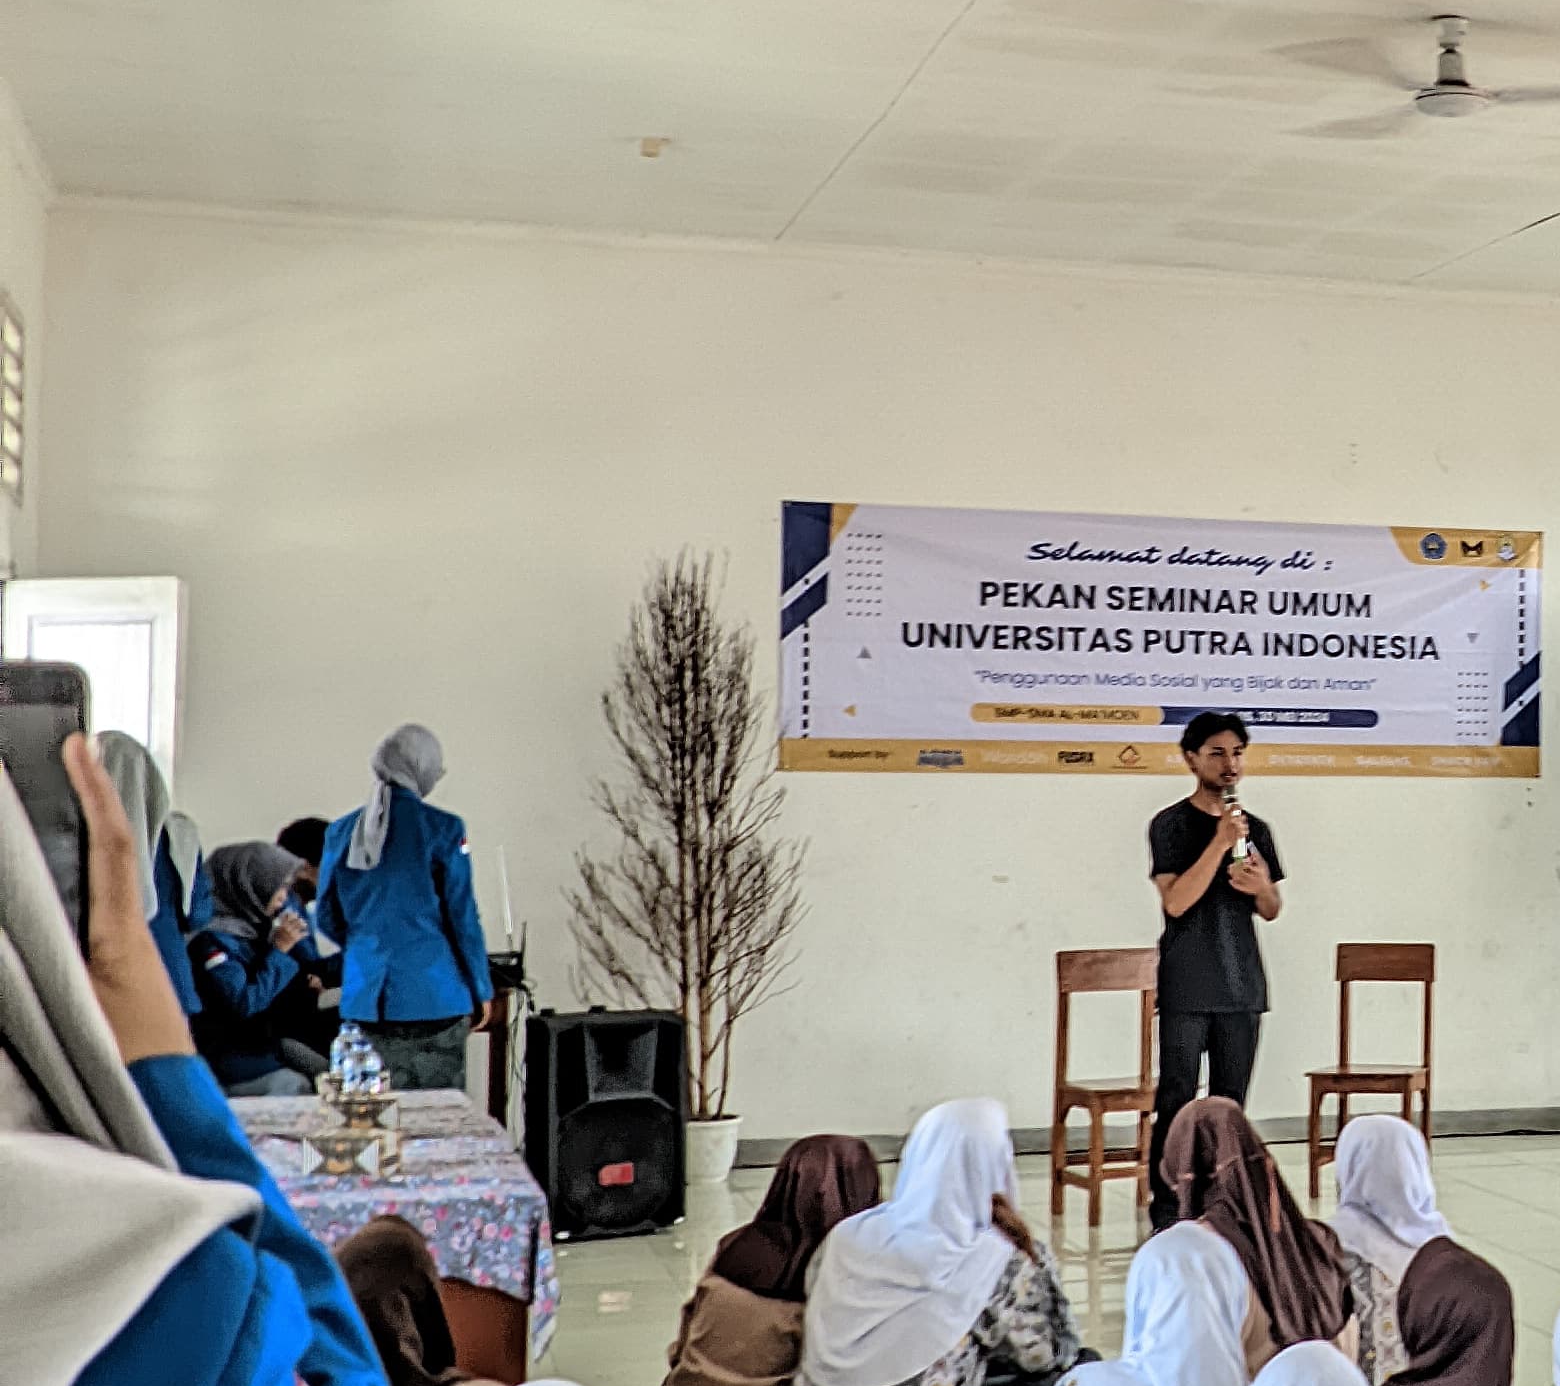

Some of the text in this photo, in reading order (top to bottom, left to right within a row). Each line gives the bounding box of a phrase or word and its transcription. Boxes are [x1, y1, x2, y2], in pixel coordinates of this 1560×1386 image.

[1027, 541, 1162, 563] Selamat
[1167, 546, 1276, 575] datang
[1280, 551, 1316, 570] di
[980, 581, 1373, 618] PEKAN SEMINAR UMUM
[902, 621, 1440, 661] UNIVERSITAS PUTRA INDONESIA
[1094, 672, 1147, 687] Media
[1150, 673, 1198, 688] Sosial
[1202, 675, 1244, 693] yang
[1247, 675, 1284, 693] Bijak
[1287, 676, 1320, 691] dan
